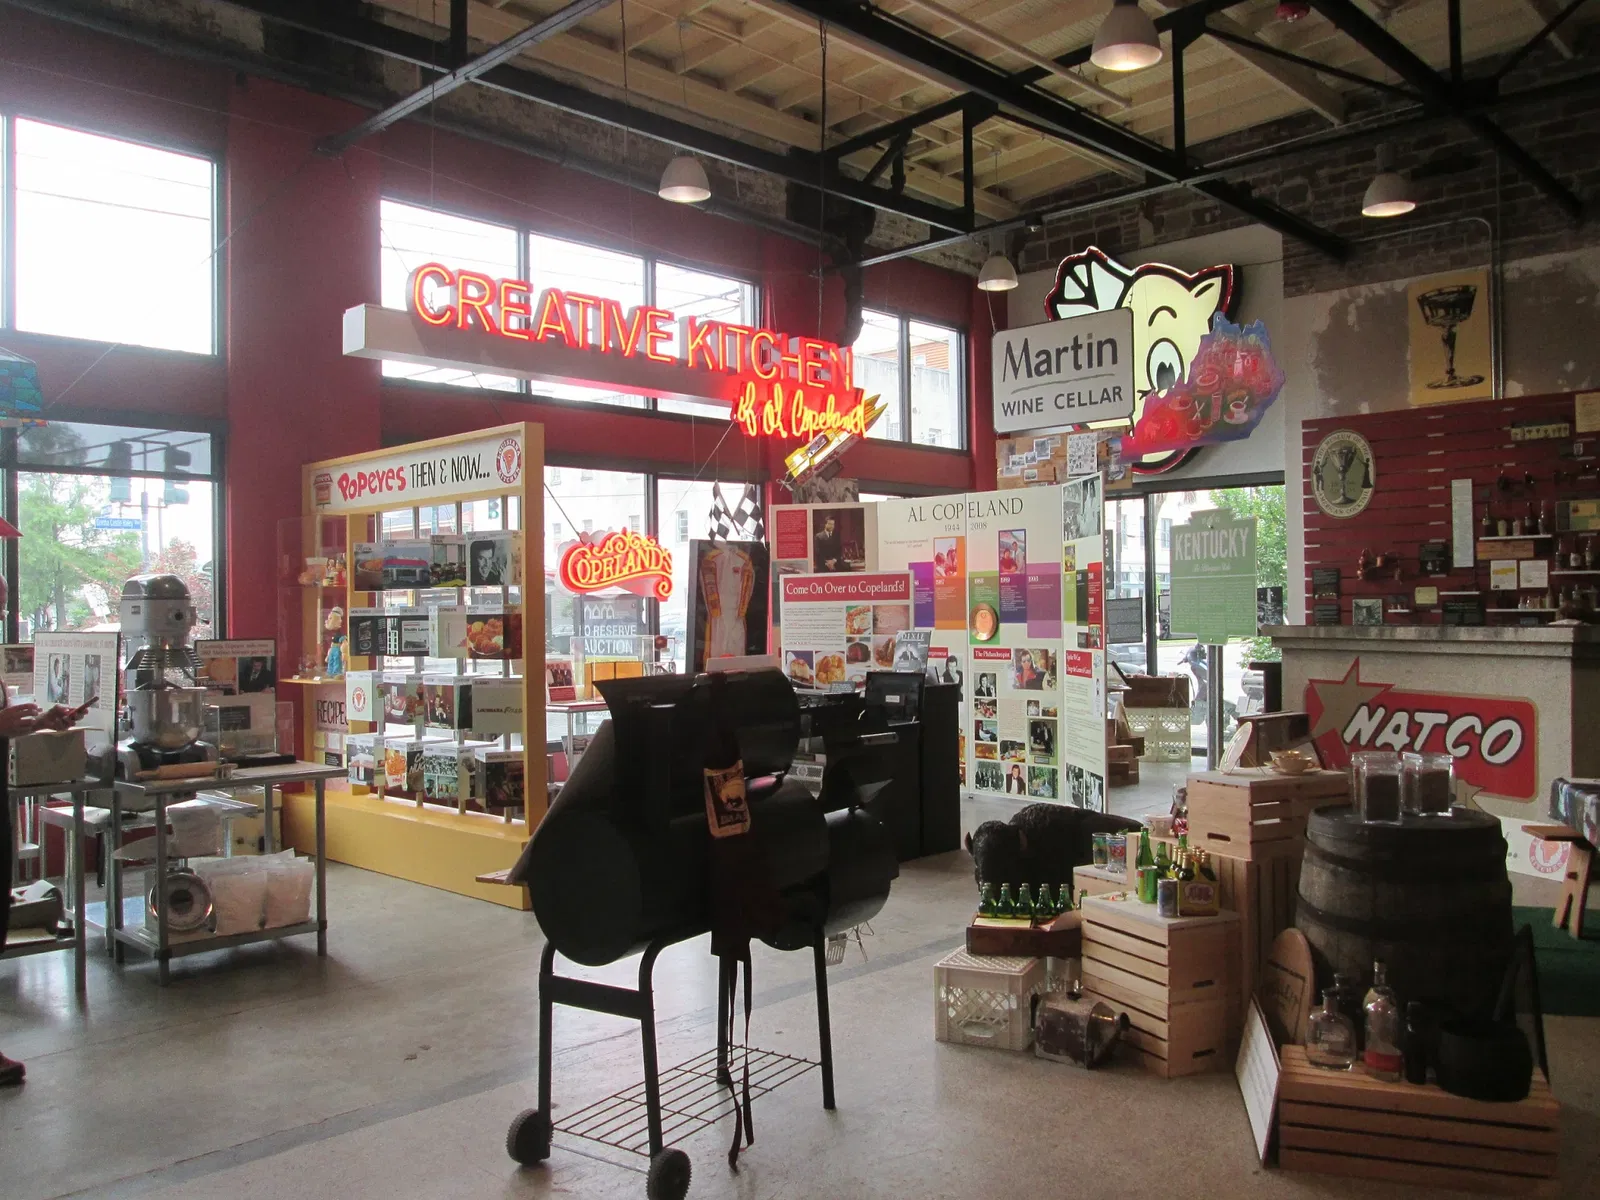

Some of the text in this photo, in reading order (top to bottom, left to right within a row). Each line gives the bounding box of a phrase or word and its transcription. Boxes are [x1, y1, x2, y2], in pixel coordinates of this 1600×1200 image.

[409, 262, 853, 391] CREATIVE KITCHEN
[1003, 332, 1117, 382] Martin
[792, 389, 867, 441] Copeland
[1002, 386, 1123, 417] WINE CELLAR
[410, 459, 436, 489] THEN
[908, 497, 1023, 522] AL COPELAND
[1175, 527, 1249, 561] KENTUCKY
[786, 582, 808, 595] Come
[810, 582, 823, 594] On
[824, 581, 846, 594] Over
[848, 583, 857, 592] to
[858, 580, 905, 596] Copeland's!
[584, 638, 633, 654] AUCTION
[593, 625, 637, 637] RESERVE
[1343, 705, 1524, 765] NATCO
